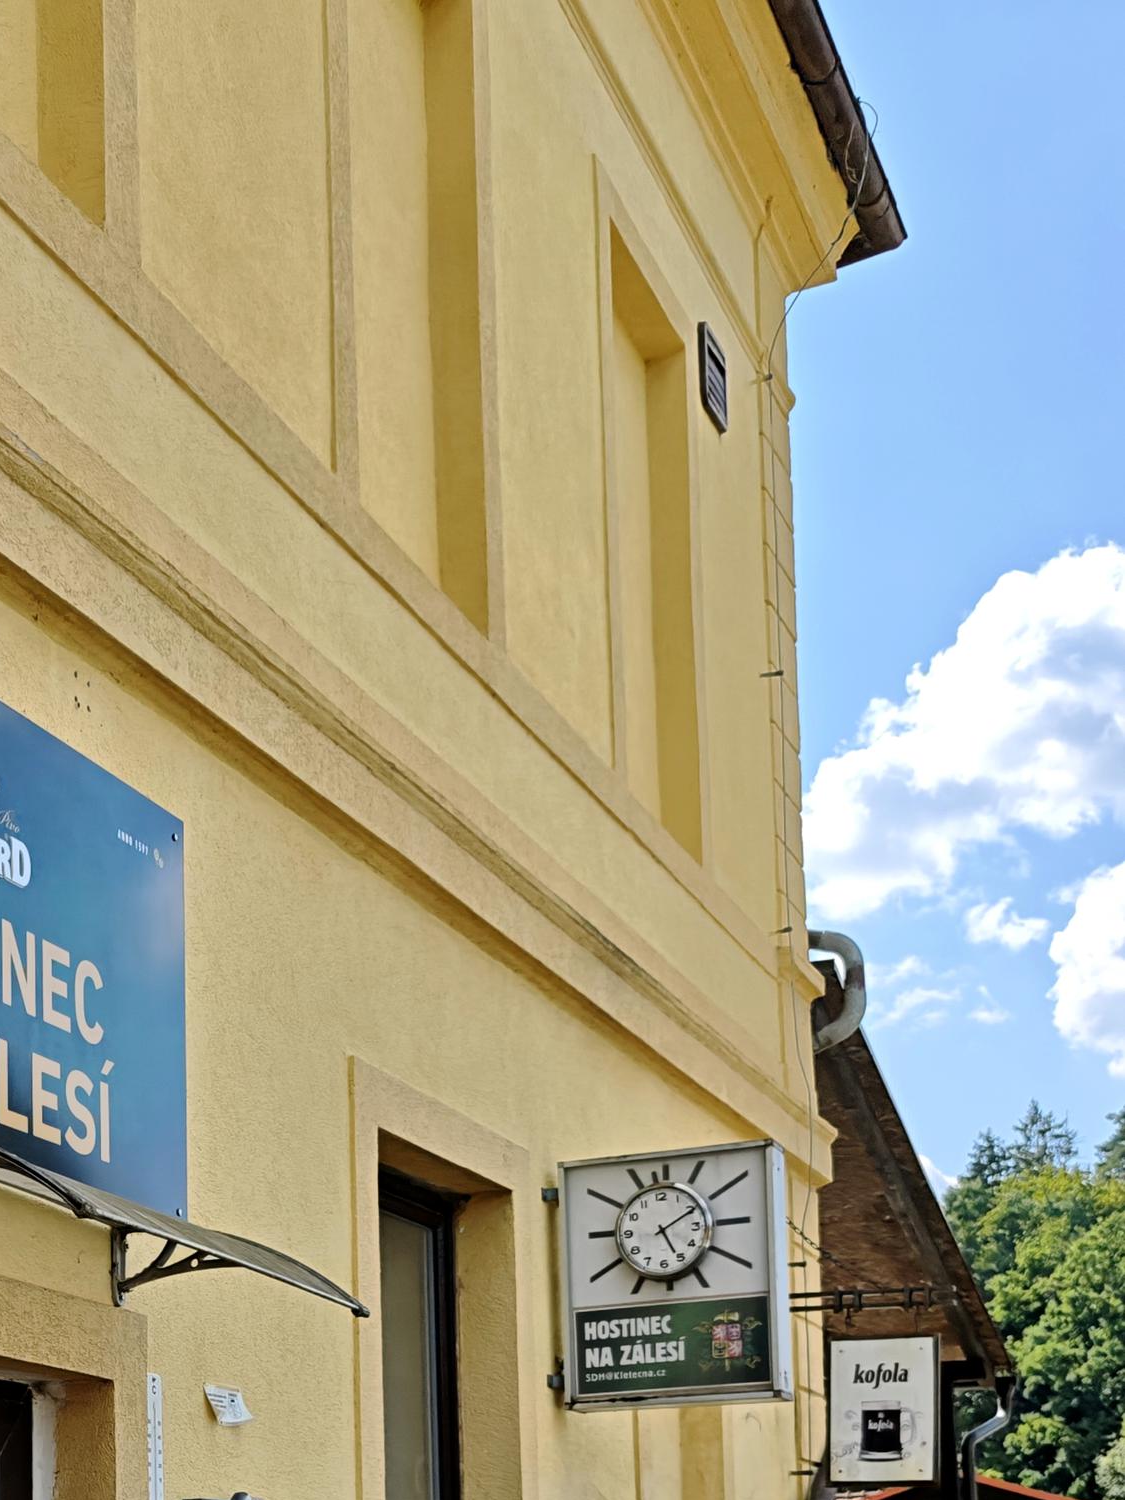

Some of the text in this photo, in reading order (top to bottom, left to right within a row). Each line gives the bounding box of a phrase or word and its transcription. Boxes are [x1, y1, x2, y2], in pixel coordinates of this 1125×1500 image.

[655, 1192, 667, 1201] 12
[640, 1200, 647, 1209] 11
[629, 1213, 639, 1221] 10
[691, 1222, 700, 1231] 3
[624, 1230, 633, 1239] 9
[687, 1239, 696, 1247] 4
[630, 1246, 640, 1255] 8
[643, 1257, 651, 1266] 7
[676, 1253, 685, 1262] 5
[659, 1259, 669, 1268] 6
[584, 1315, 672, 1341] HOSTINEC
[585, 1336, 687, 1368] NA ZÁLESÍ
[853, 1362, 909, 1389] kofola
[867, 1419, 894, 1432] kofola
